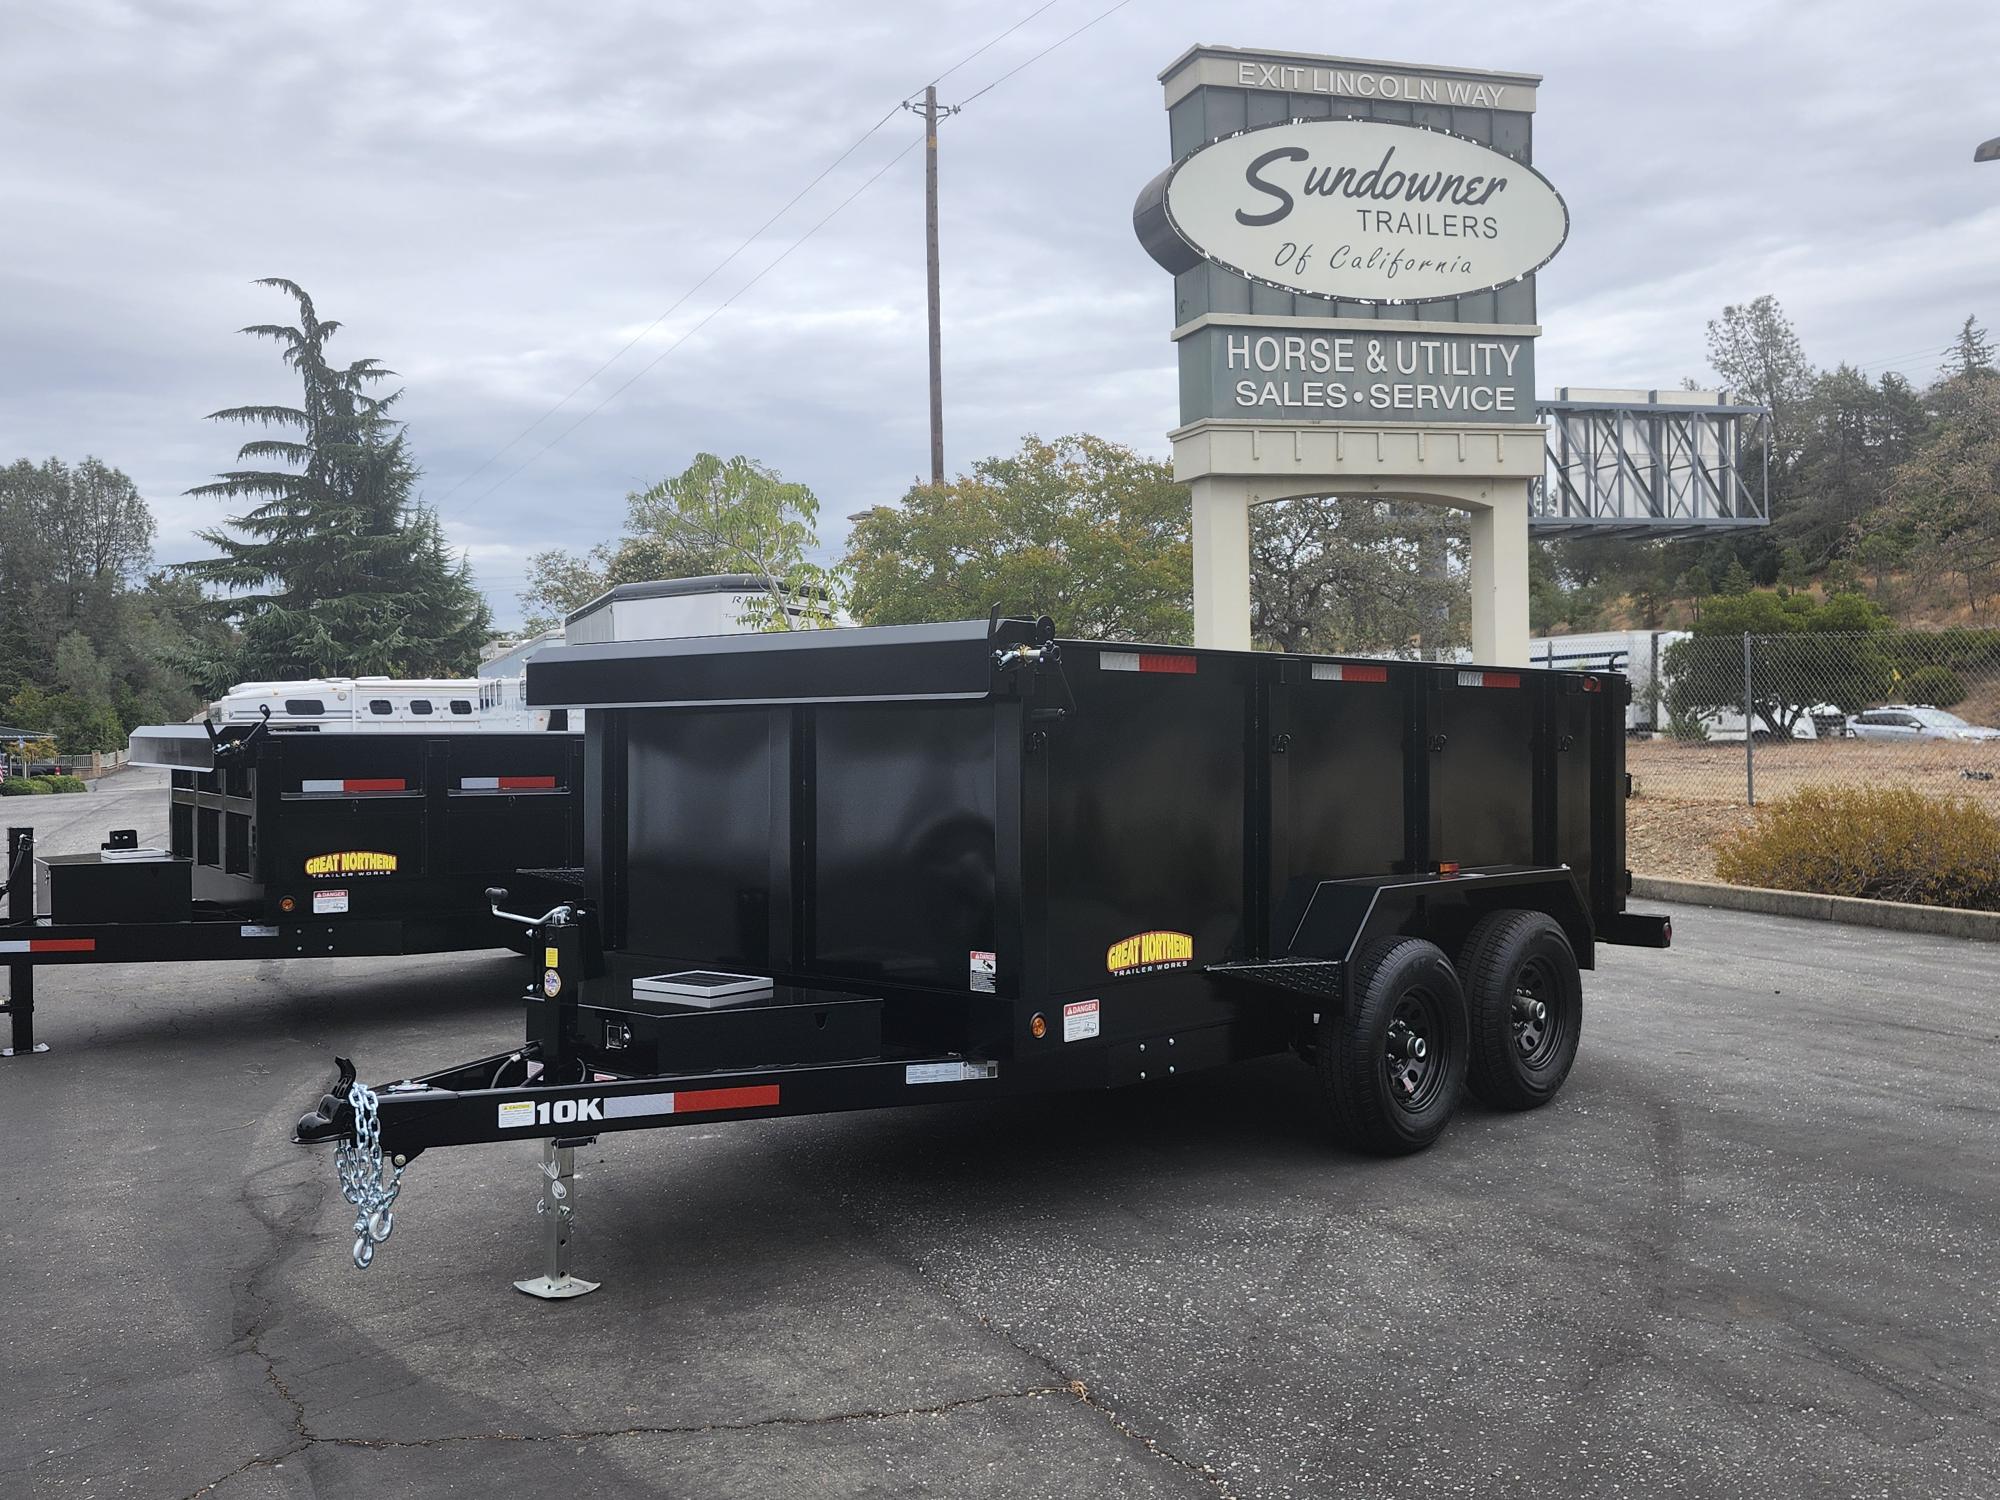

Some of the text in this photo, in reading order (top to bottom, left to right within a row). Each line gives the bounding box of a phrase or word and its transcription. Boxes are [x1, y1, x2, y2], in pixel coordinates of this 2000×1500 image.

[1238, 62, 1505, 107] EXIT LINCOLN WAY
[1235, 146, 1508, 227] Sundowner
[1356, 209, 1498, 239] TRAILERS
[1274, 242, 1473, 279] Of California
[1227, 335, 1520, 377] HORSE & UTILITY
[306, 852, 397, 875] GREAT NORTHERN
[1109, 933, 1192, 970] GREAT NORTHERN
[1114, 960, 1188, 977] TRAILER WORKS
[1072, 1003, 1097, 1014] DANGER
[537, 1098, 603, 1125] 10K
